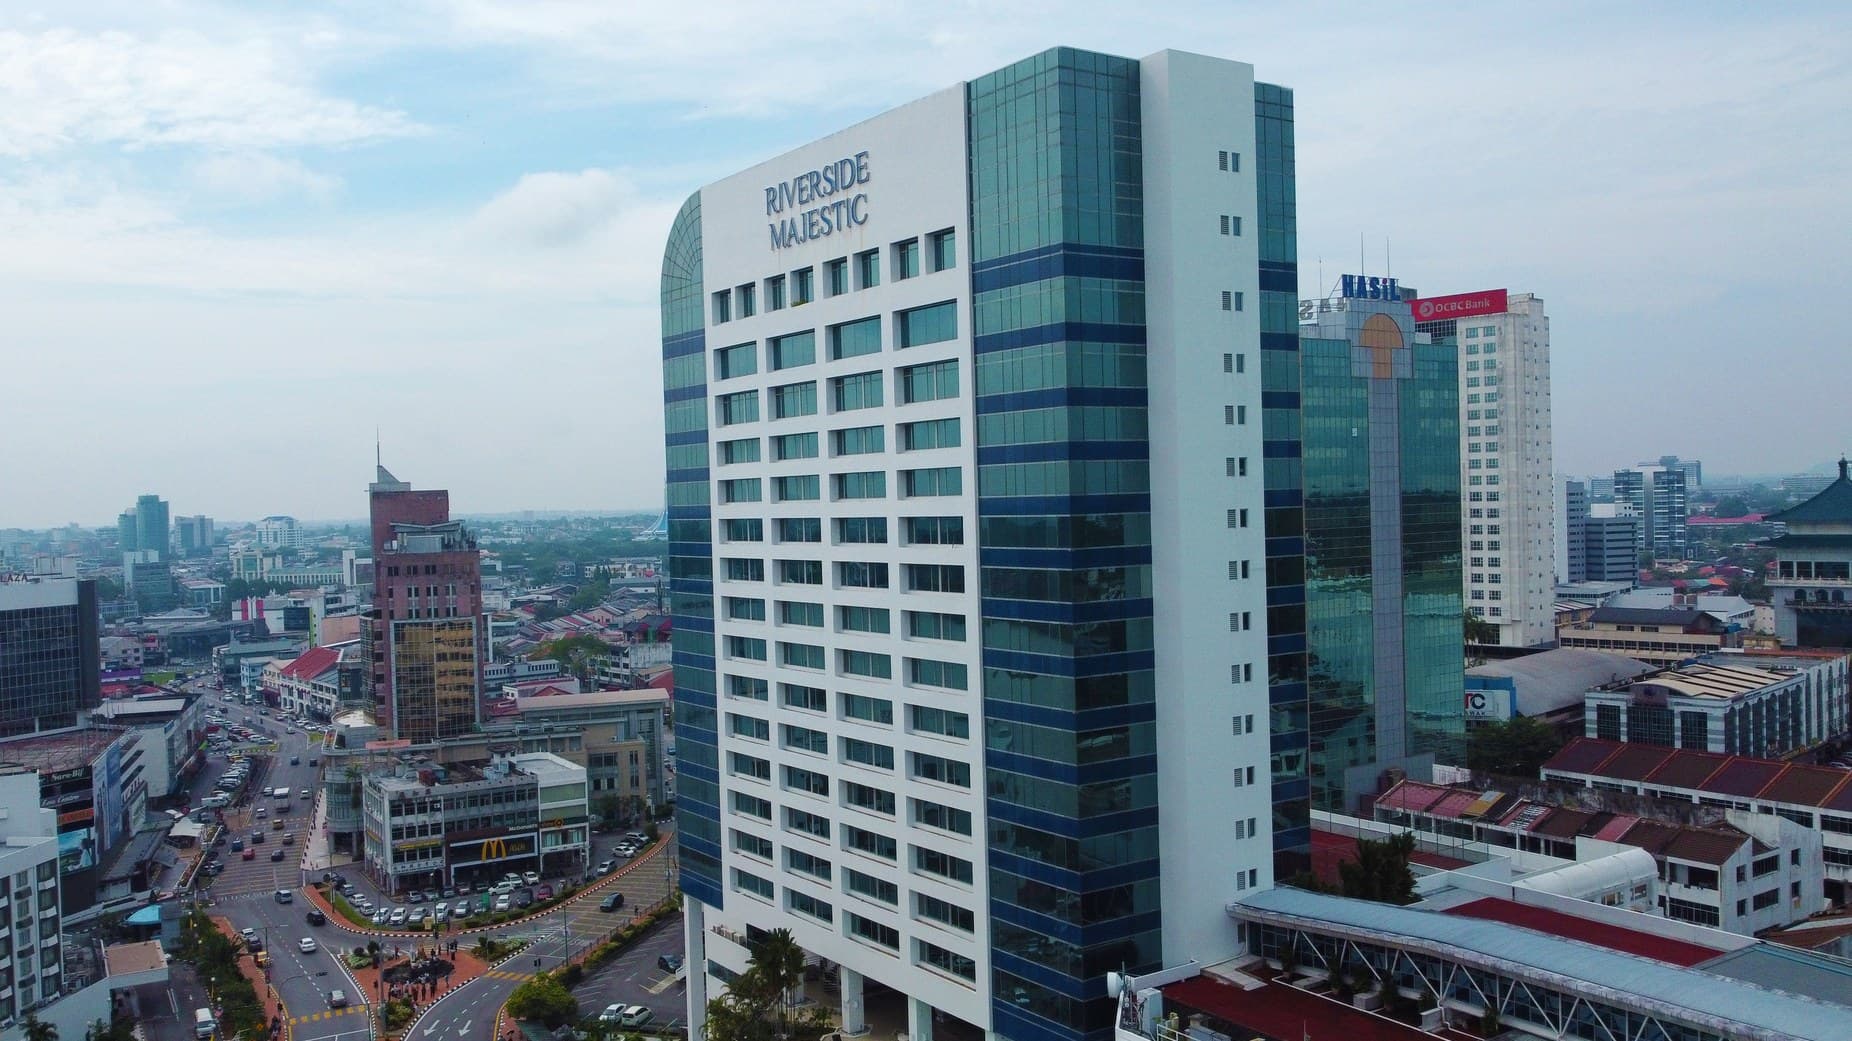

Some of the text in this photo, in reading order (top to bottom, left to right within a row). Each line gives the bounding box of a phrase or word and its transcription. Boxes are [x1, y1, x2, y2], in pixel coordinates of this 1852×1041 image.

[765, 151, 870, 216] RIVERSIDE
[769, 193, 868, 251] MAJESTIC
[1435, 298, 1490, 313] OCBC Bank
